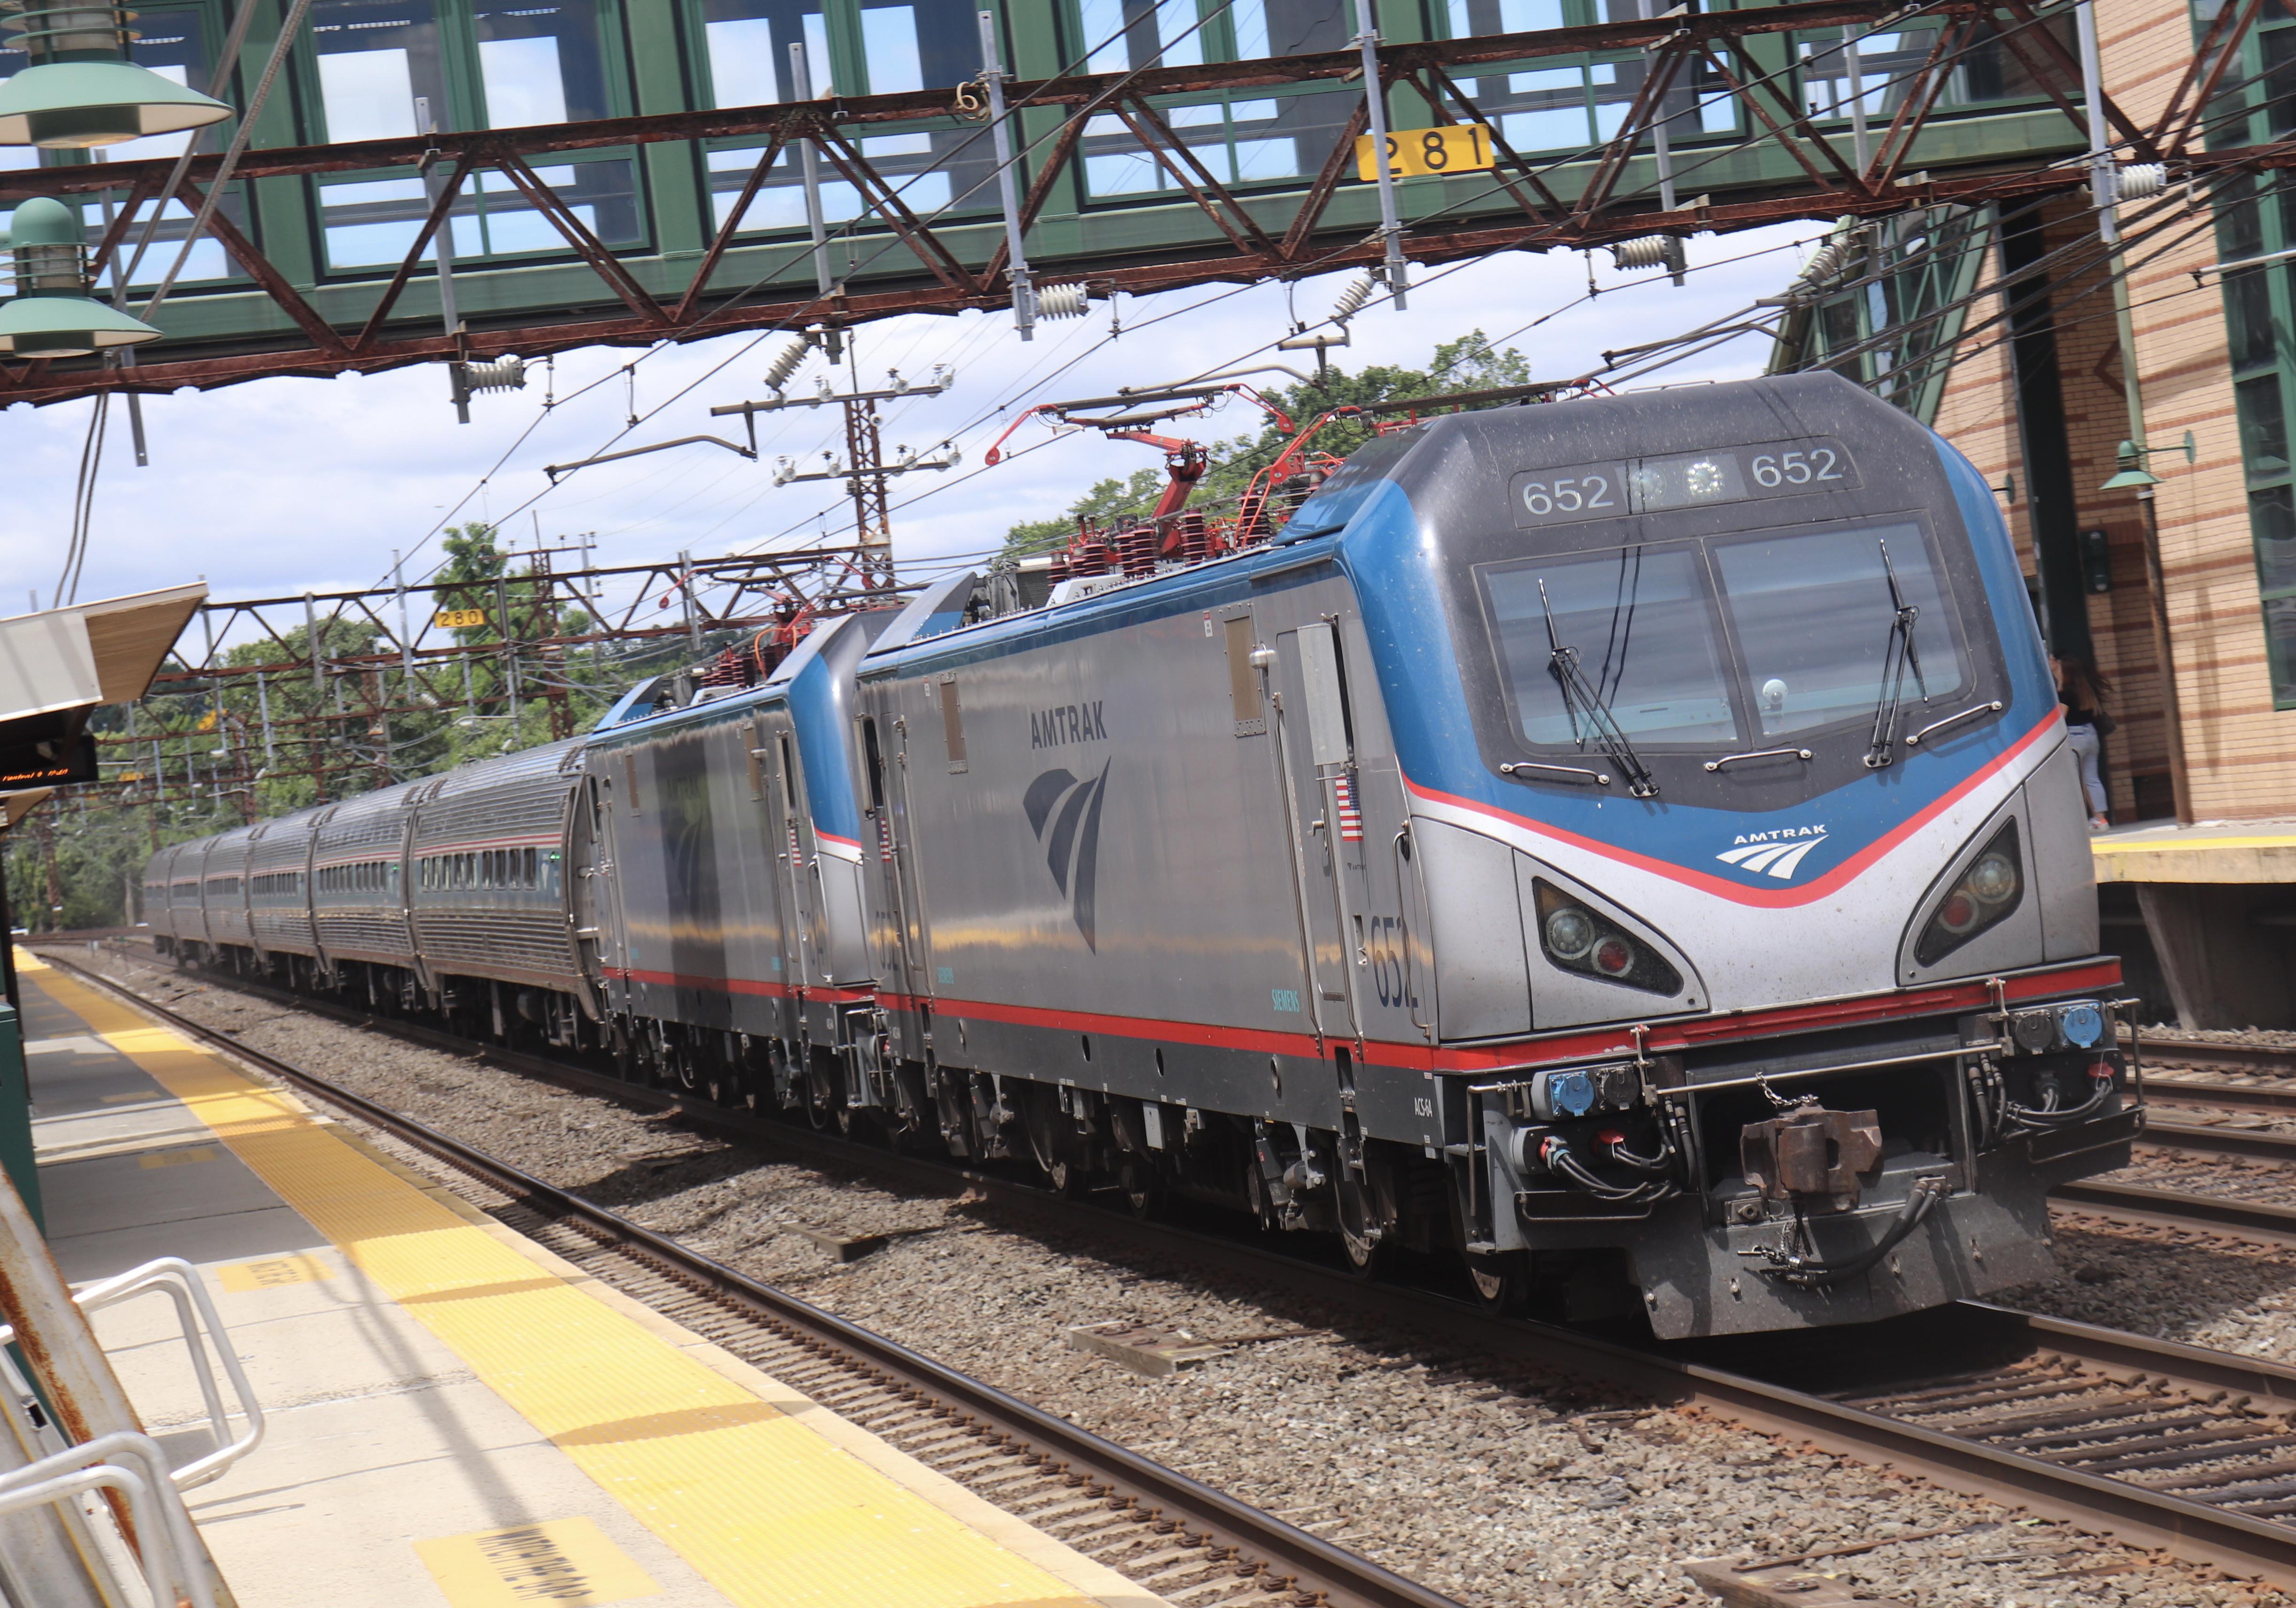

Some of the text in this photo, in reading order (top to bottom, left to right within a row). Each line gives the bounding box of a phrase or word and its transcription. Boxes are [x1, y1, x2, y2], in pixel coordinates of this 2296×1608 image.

[1522, 448, 1843, 515] 652 652
[440, 611, 478, 626] 280
[1031, 700, 1108, 750] AMTRAK
[1734, 824, 1827, 845] AMTRAK
[1371, 916, 1418, 1008] 652
[1271, 988, 1300, 1013] SIEMENS
[475, 1528, 595, 1600] WATCH THE GAP
